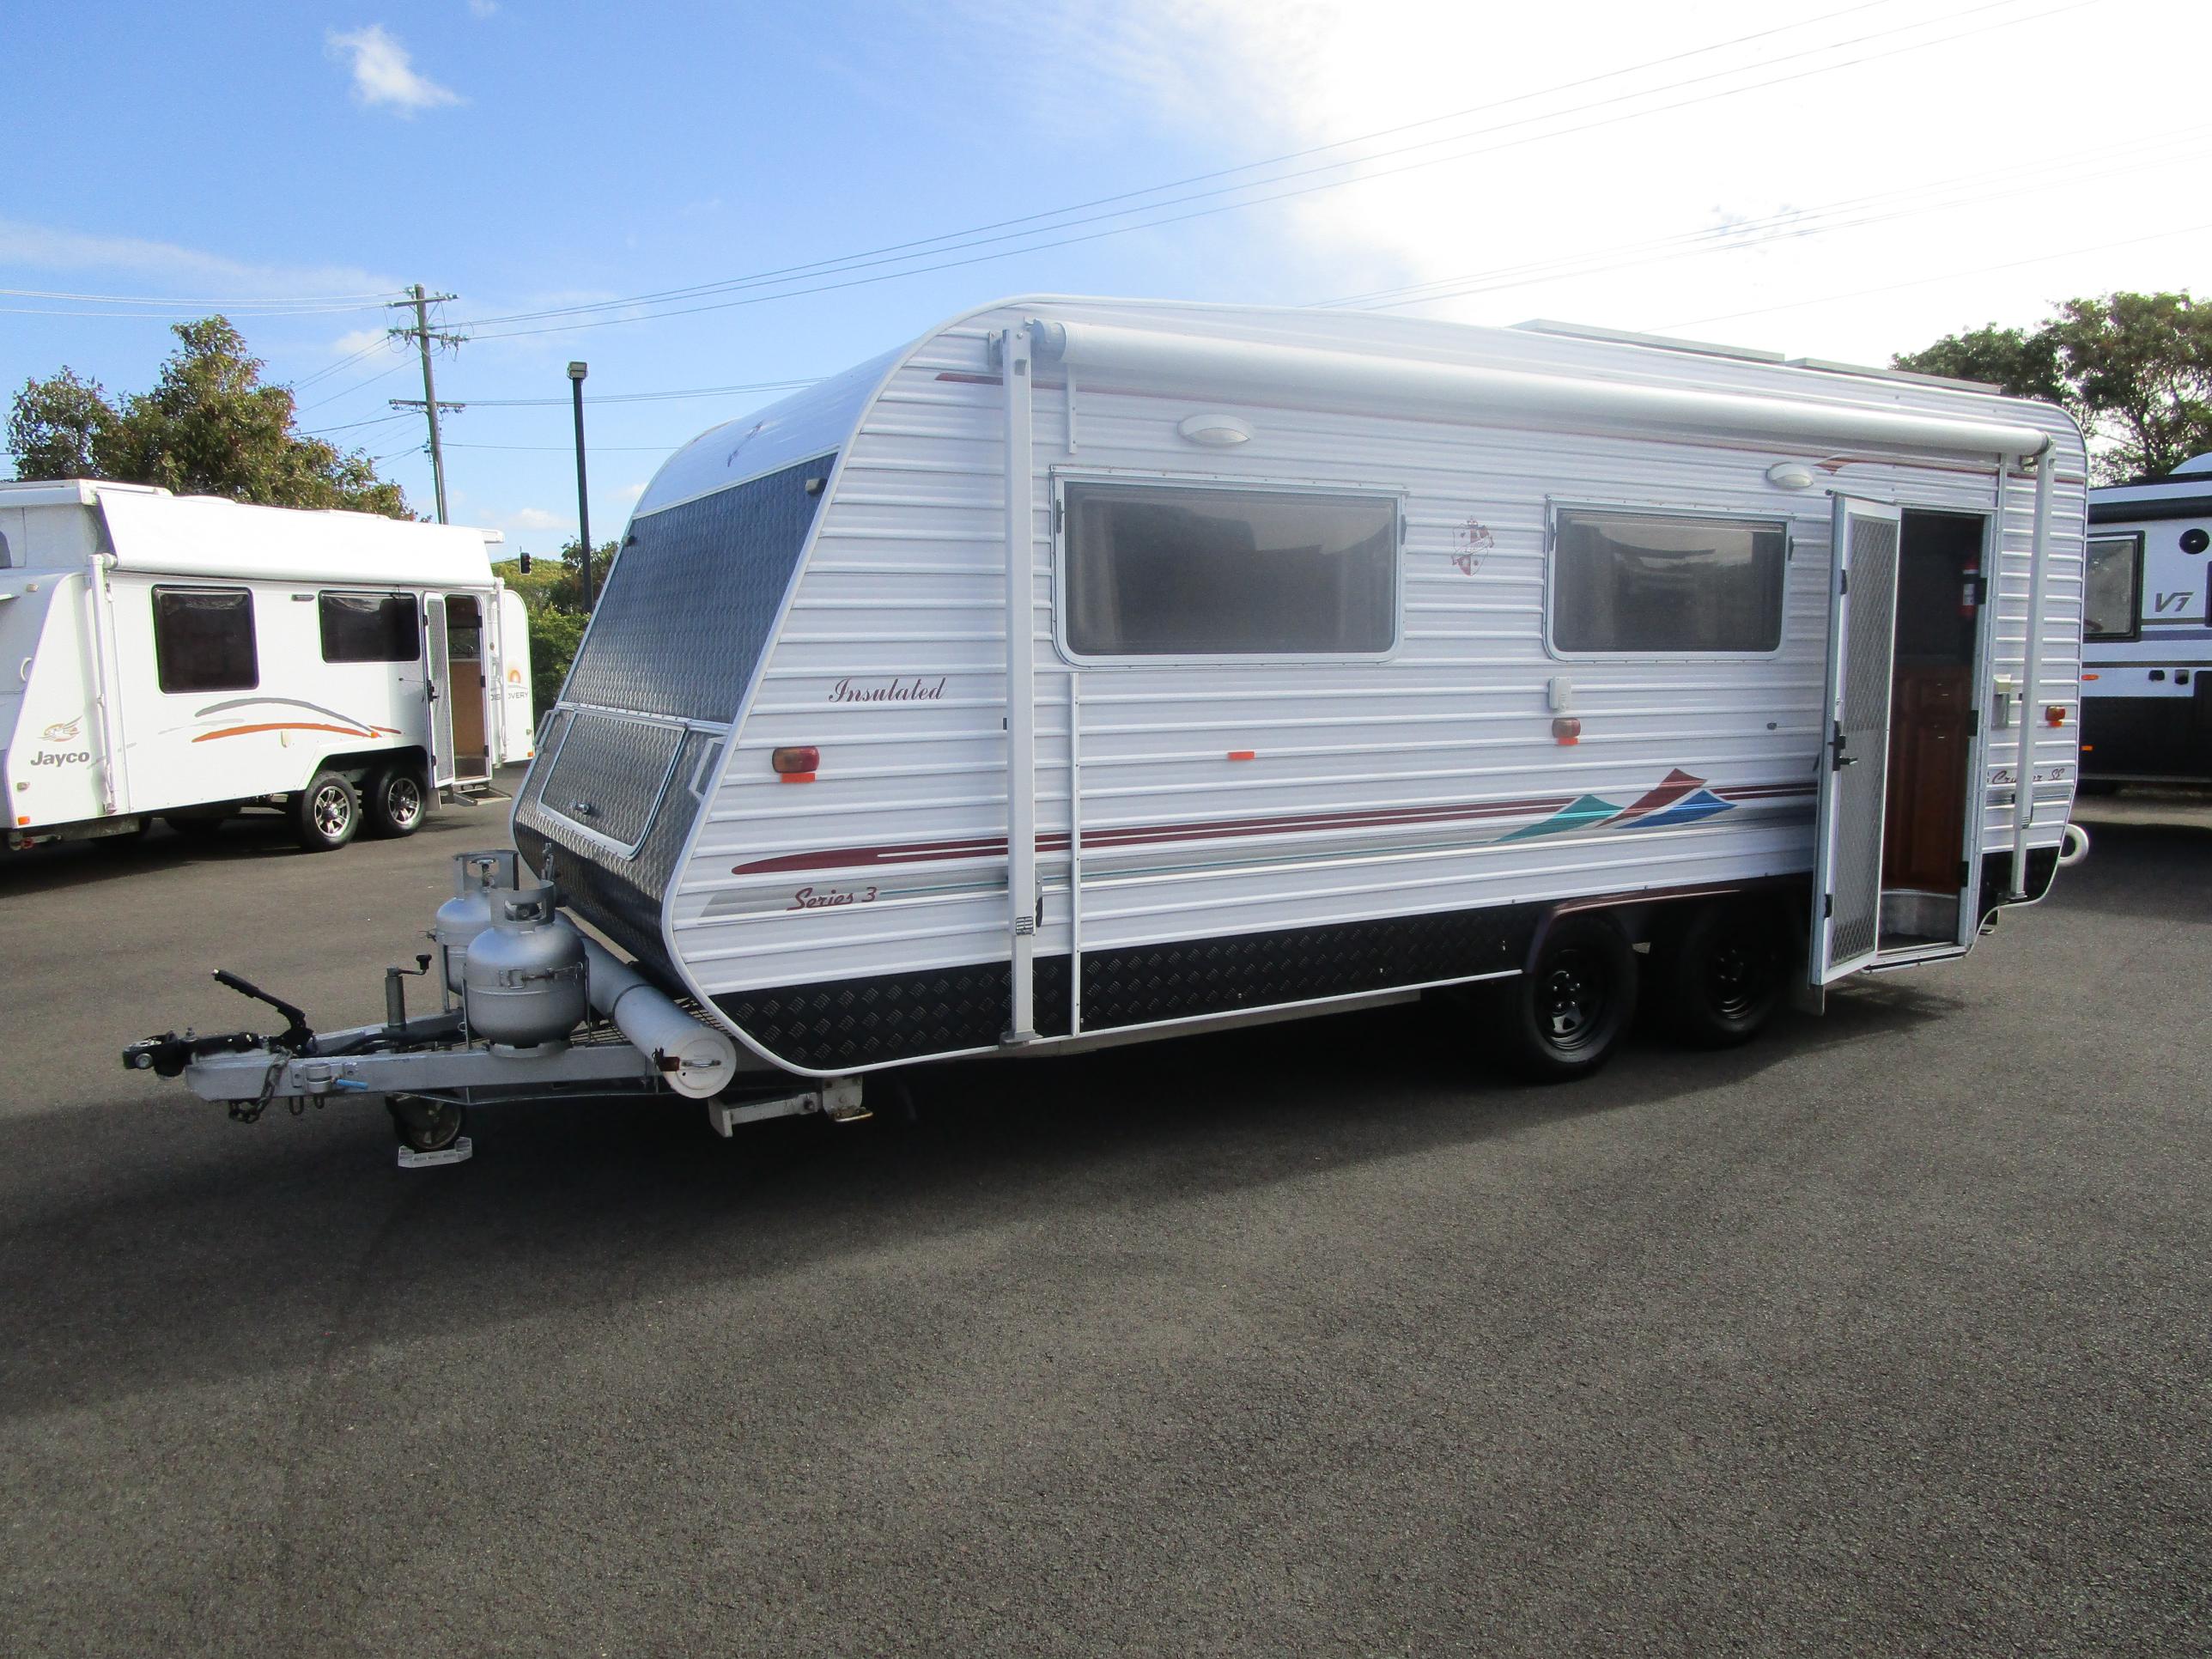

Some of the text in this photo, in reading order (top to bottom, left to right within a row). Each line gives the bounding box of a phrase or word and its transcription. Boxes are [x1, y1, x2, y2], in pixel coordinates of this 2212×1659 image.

[489, 691, 529, 701] DISVERY
[829, 677, 947, 702] Insulated
[30, 750, 90, 767] Jayco
[787, 886, 878, 911] Series 3
